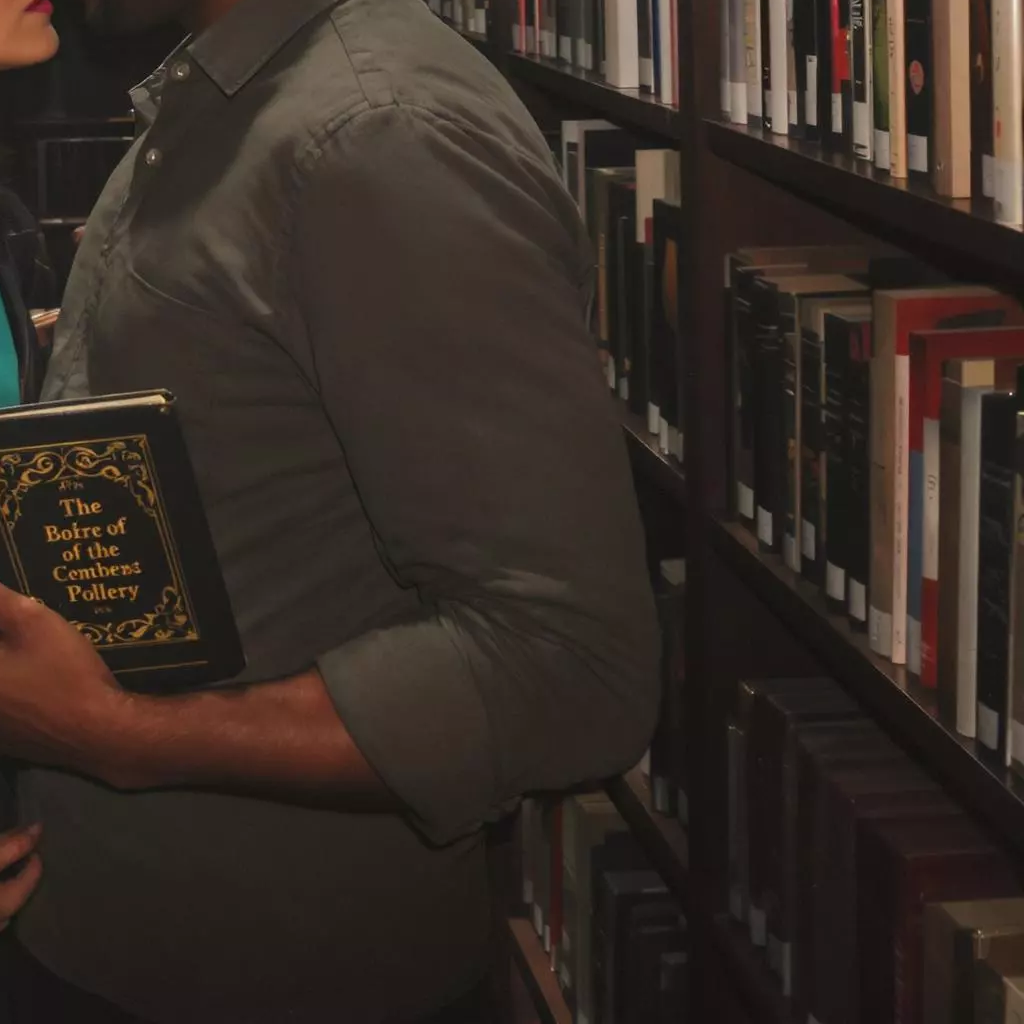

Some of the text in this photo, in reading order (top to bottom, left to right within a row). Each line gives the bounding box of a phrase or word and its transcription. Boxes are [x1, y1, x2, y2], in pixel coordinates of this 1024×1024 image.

[59, 498, 103, 517] The
[106, 516, 127, 536] of
[62, 541, 120, 562] of the
[65, 583, 140, 603] Pollery
